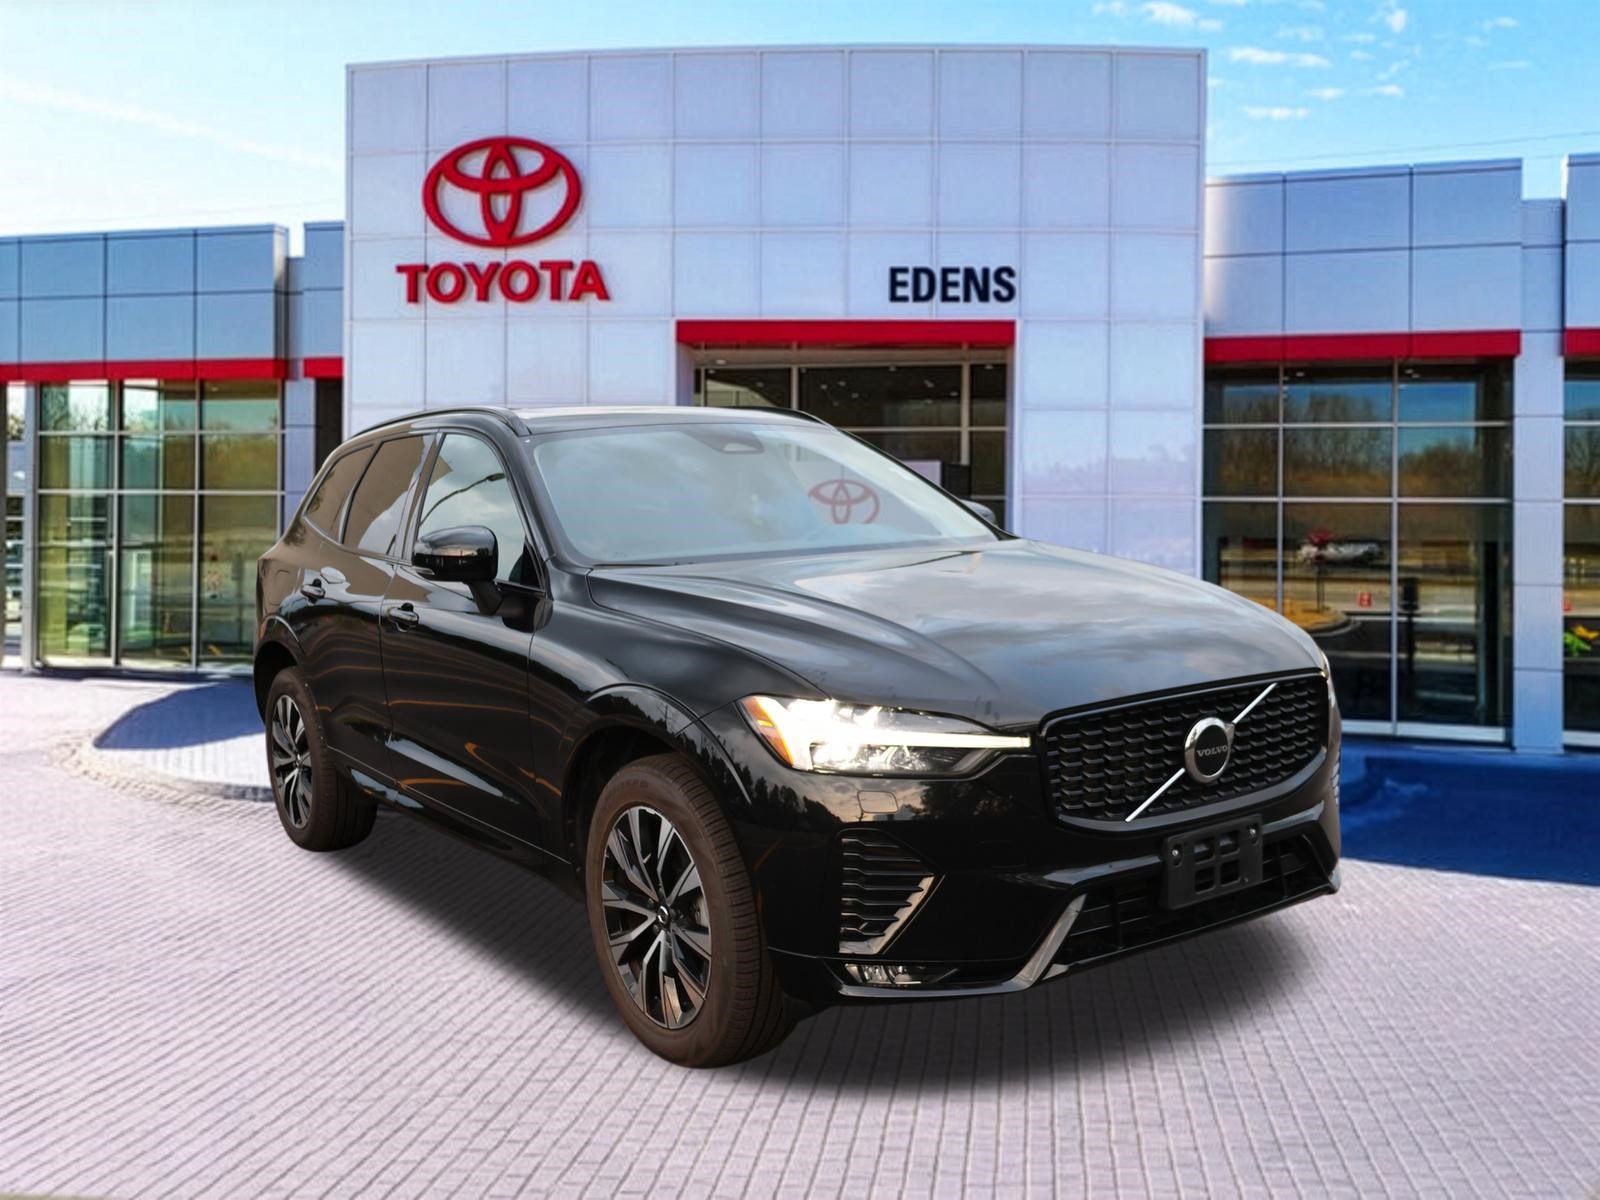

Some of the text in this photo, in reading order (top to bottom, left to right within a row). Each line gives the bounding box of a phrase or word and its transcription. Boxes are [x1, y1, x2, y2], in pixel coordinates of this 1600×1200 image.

[396, 260, 611, 304] TOYOTA
[889, 266, 1017, 303] EDENS
[1196, 745, 1228, 757] VOLVO
